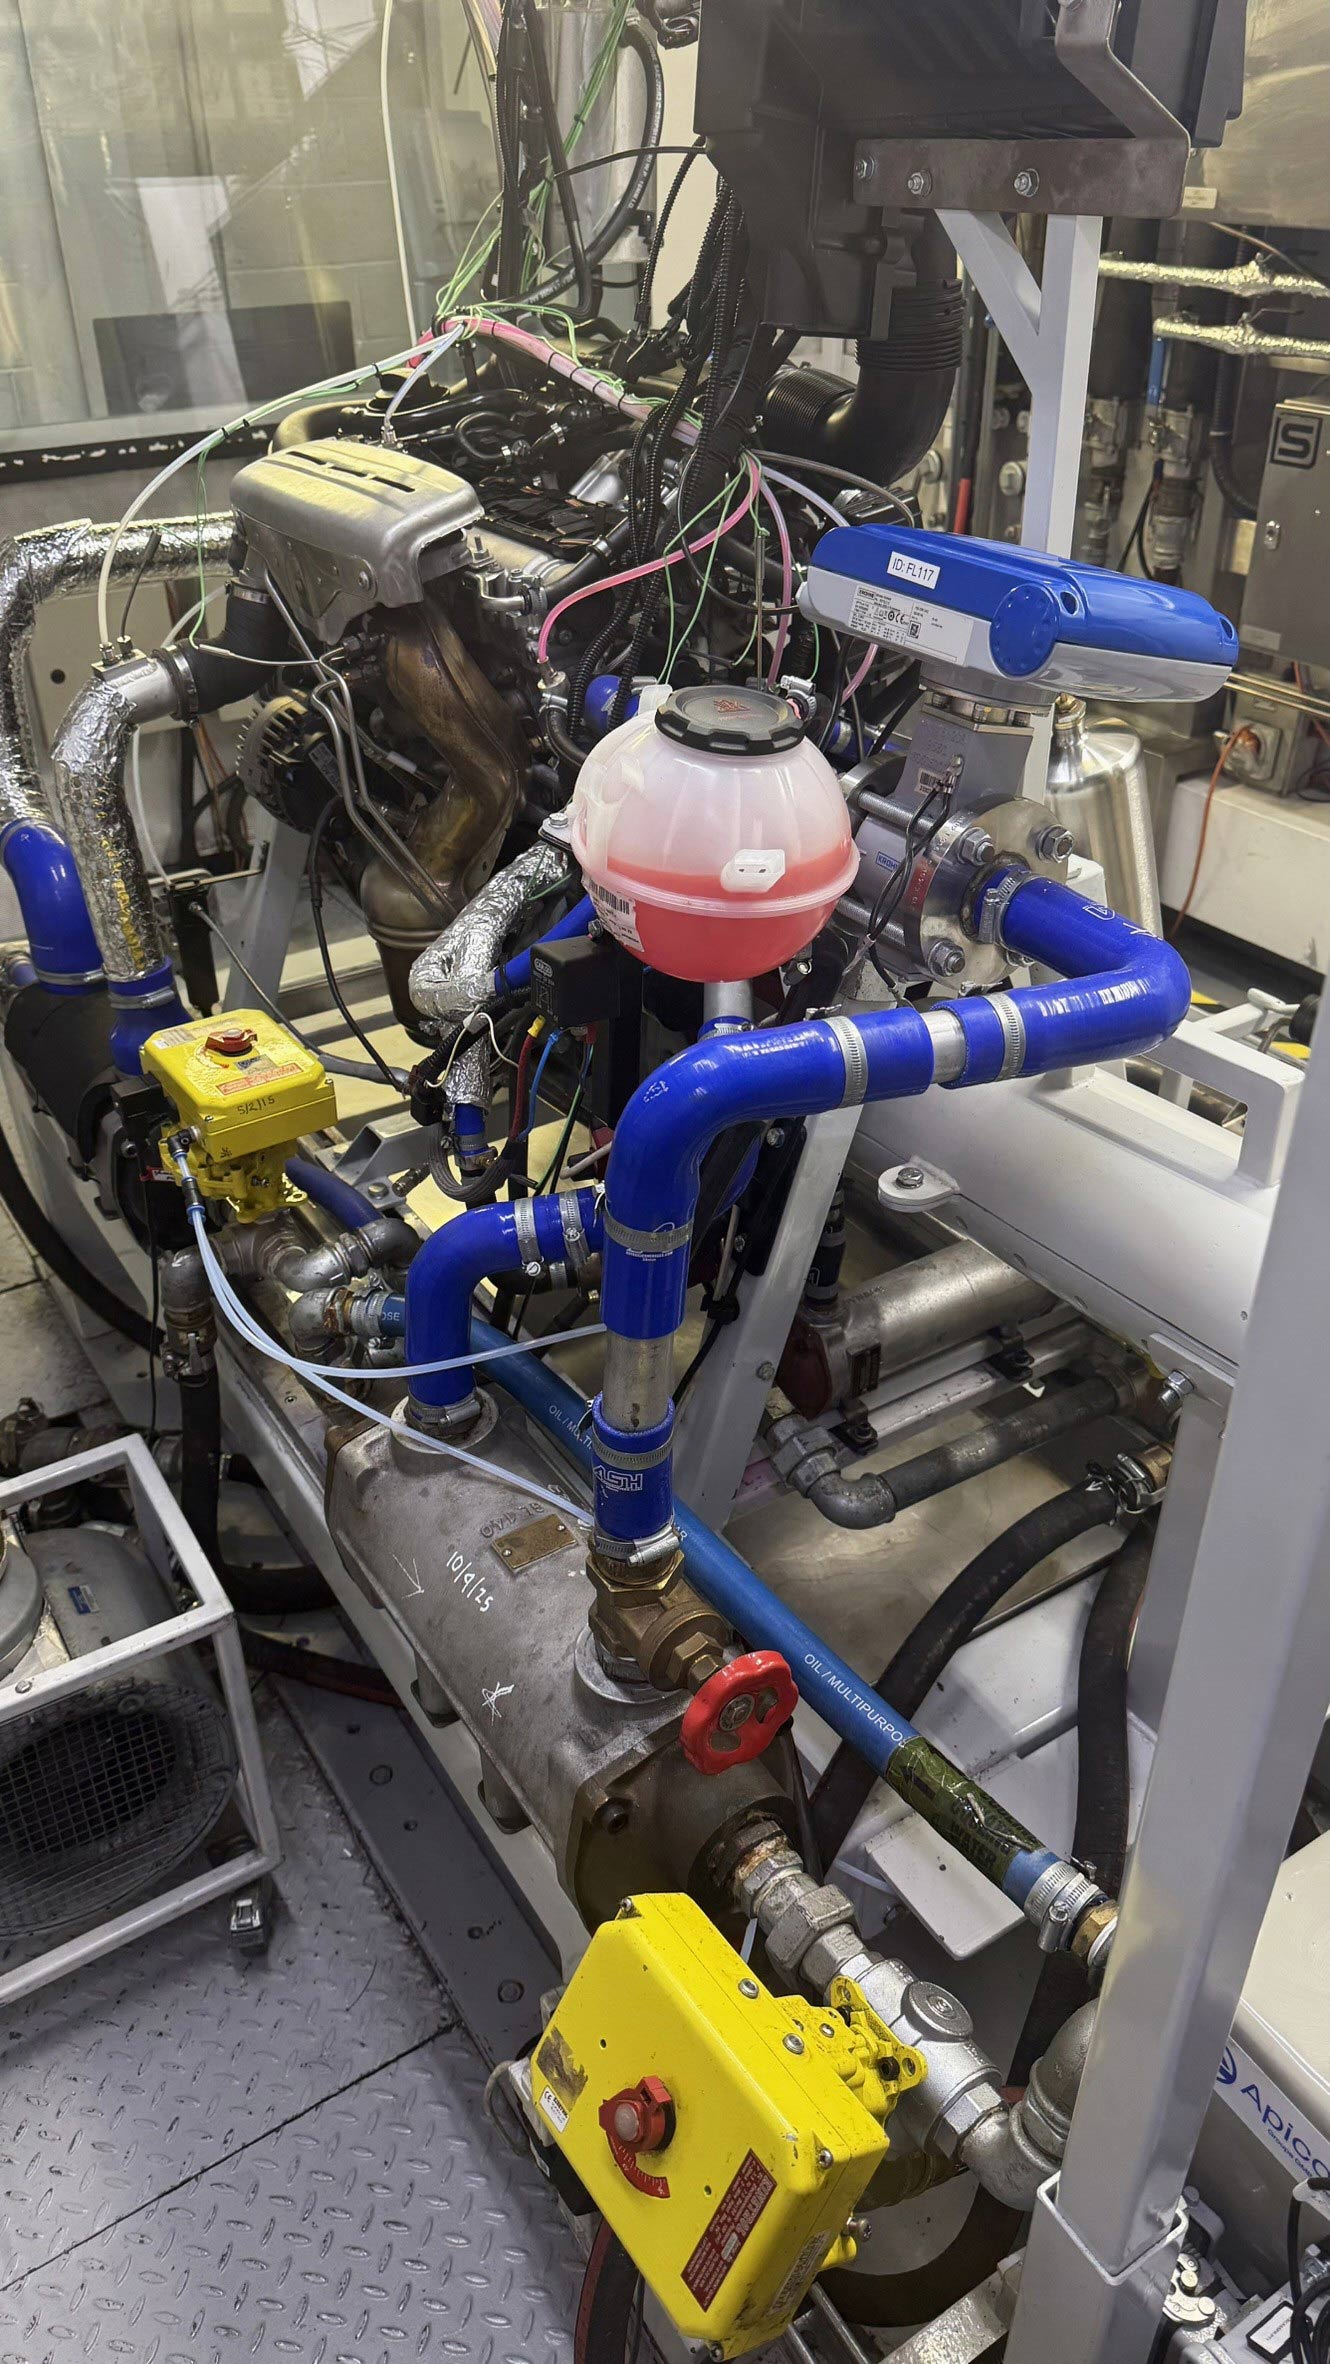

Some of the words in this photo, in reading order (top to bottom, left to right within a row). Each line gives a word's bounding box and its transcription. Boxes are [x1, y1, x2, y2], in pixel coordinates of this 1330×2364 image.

[892, 558, 905, 573] ID:
[906, 562, 935, 582] FL117
[877, 852, 899, 870] KROH
[549, 1405, 564, 1420] OIL
[446, 1551, 494, 1613] 10/9/25
[804, 1654, 822, 1674] OIL
[827, 1675, 906, 1748] MULTIPURPO
[1240, 2084, 1330, 2178] Apico
